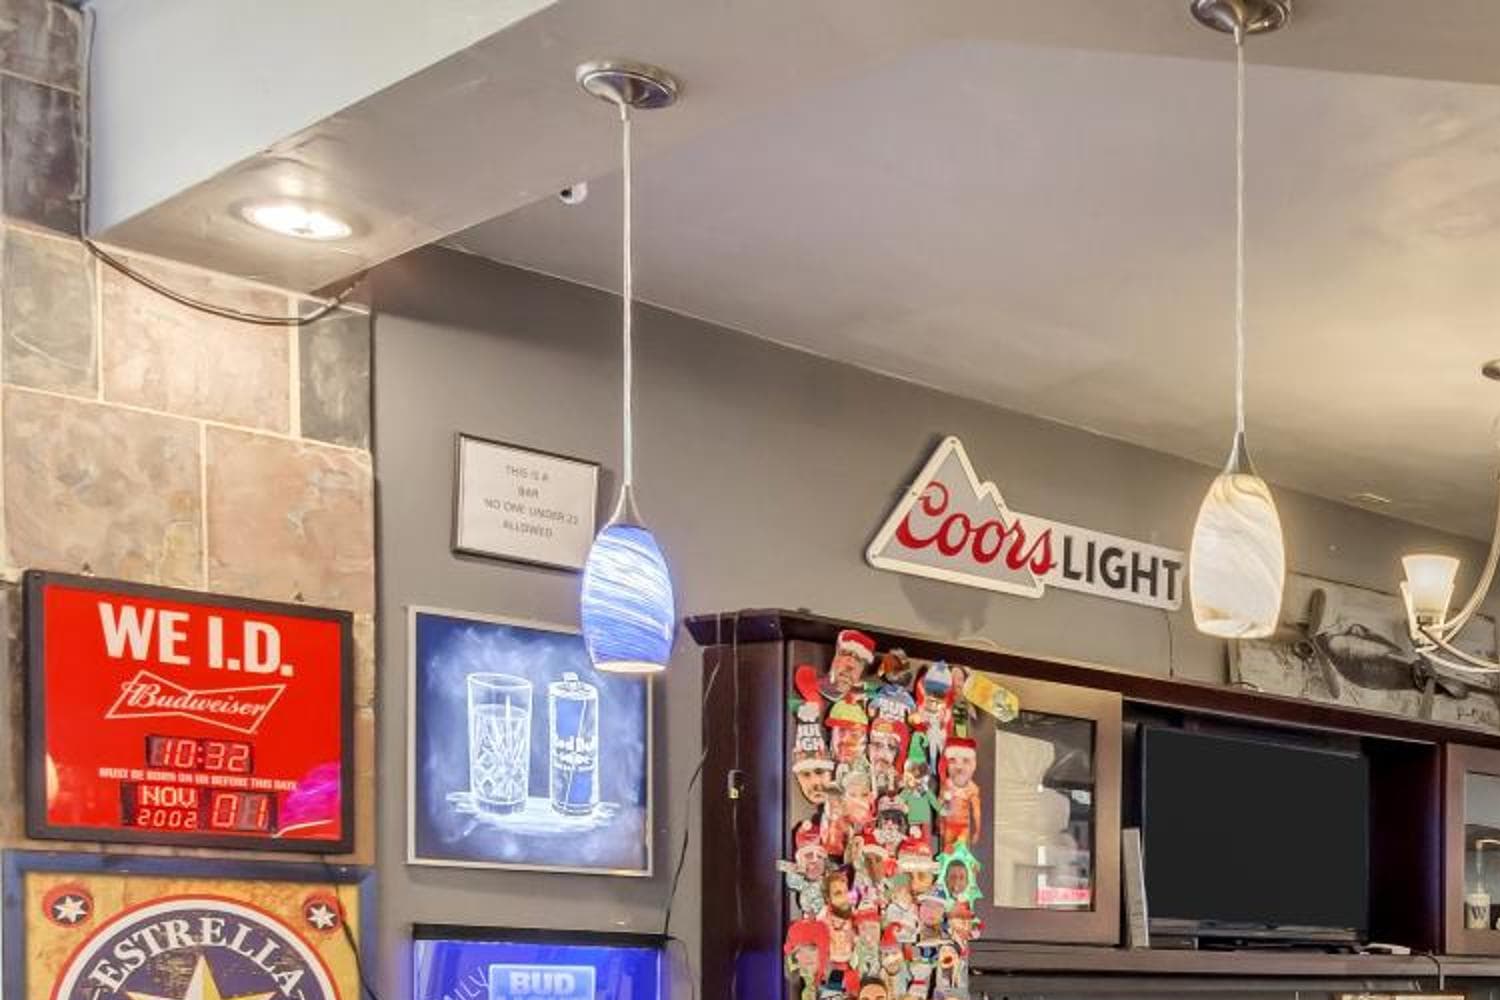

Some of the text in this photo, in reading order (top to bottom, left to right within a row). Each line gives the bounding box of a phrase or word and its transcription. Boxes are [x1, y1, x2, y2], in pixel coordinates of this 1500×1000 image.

[505, 465, 528, 480] THIS
[484, 498, 501, 510] NO
[503, 500, 526, 515] ONE
[529, 507, 565, 521] UNDER
[502, 519, 553, 538] ALLOWED
[896, 481, 1182, 601] Coors LIGHT
[98, 602, 295, 677] WE I.D.
[120, 678, 267, 717] Budweiser
[163, 739, 250, 772] 10:32
[211, 775, 248, 788] BEFORE
[251, 777, 273, 790] THIS
[142, 785, 198, 808] NOV
[137, 809, 198, 829] 2002
[212, 793, 269, 829] 01
[88, 917, 305, 997] ESTRELLA
[509, 971, 576, 995] BUD
